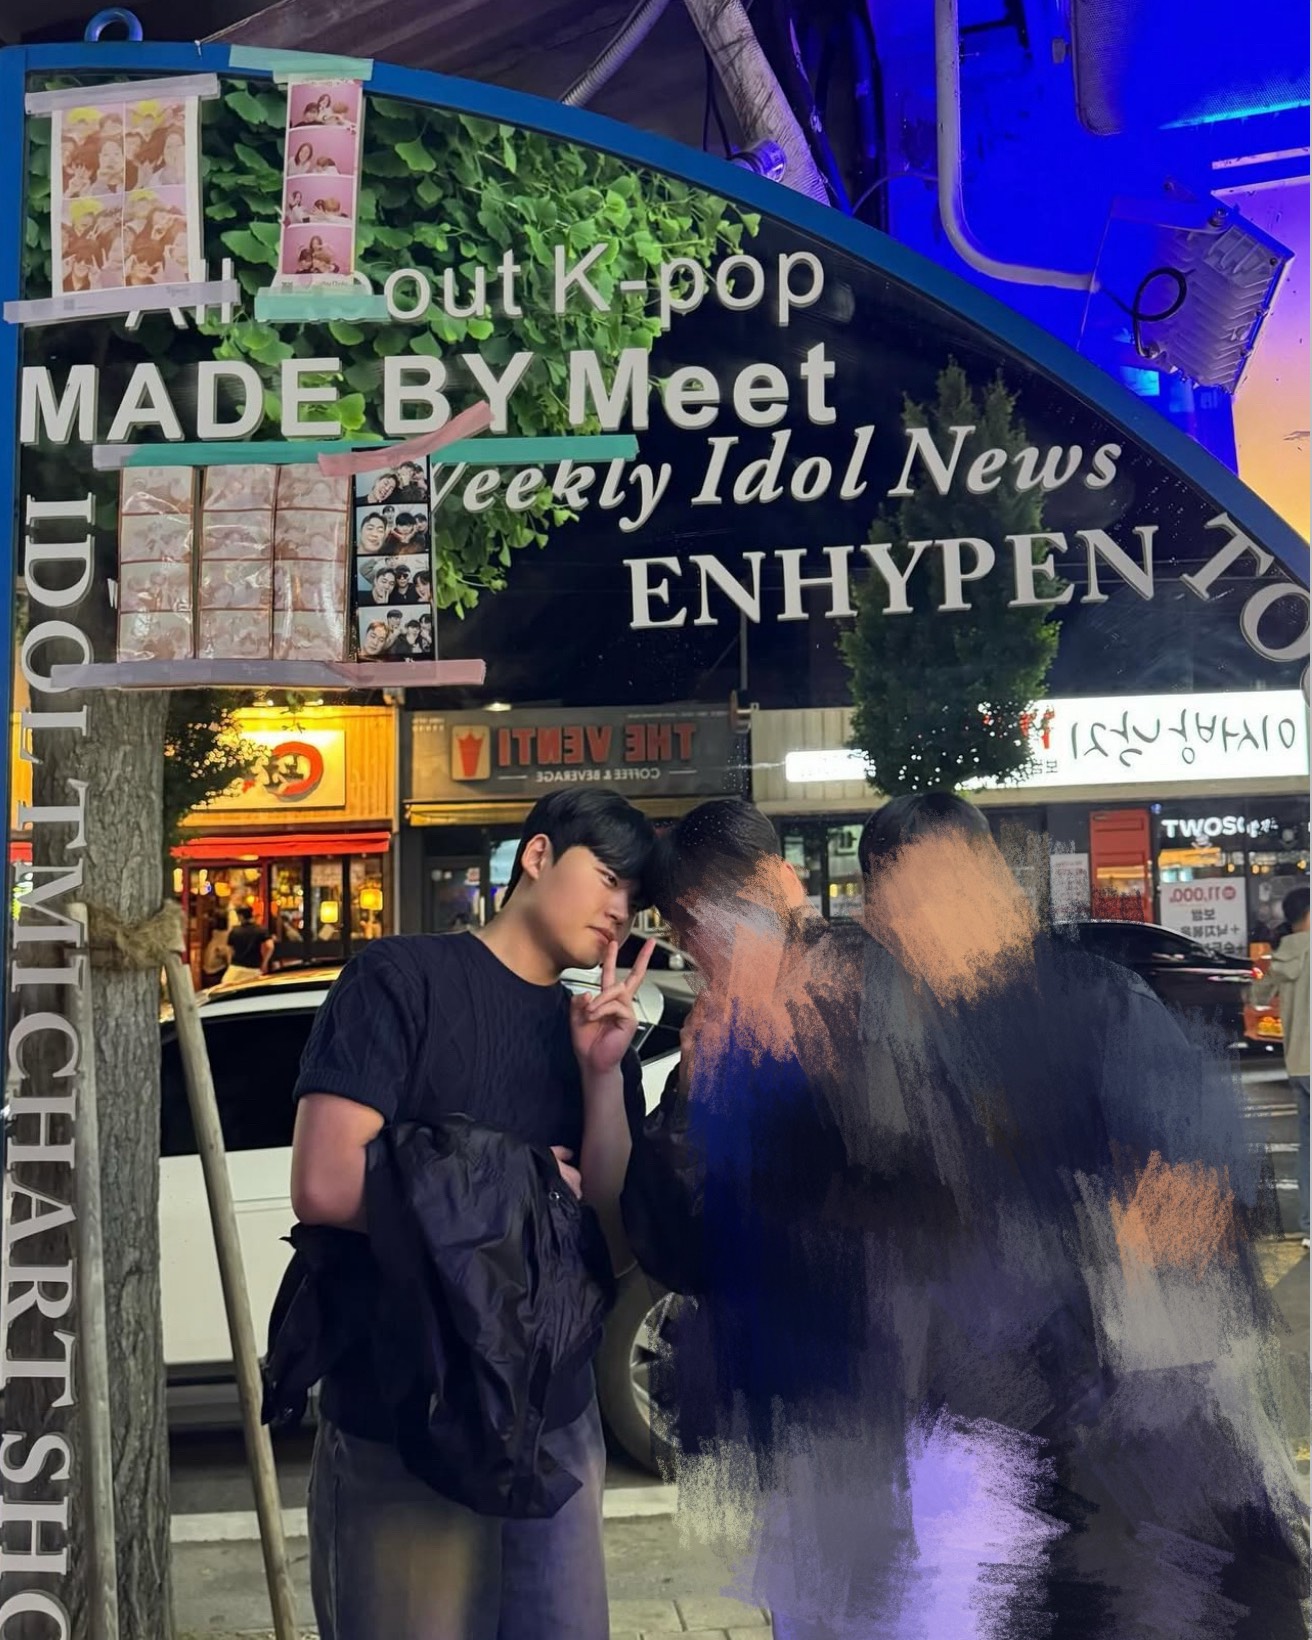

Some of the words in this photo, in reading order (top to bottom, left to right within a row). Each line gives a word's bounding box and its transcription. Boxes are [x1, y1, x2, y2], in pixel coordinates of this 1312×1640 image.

[345, 248, 522, 323] out
[555, 243, 825, 329] K-pop
[20, 357, 342, 444] MADE
[383, 351, 534, 437] BY
[568, 342, 838, 431] Meet
[691, 424, 876, 506] Idol
[888, 424, 1124, 497] News
[20, 491, 96, 767] IDOL
[622, 524, 1159, 631] ENHYPEN
[1180, 511, 1310, 706] TO
[11, 778, 90, 994] TMI
[3, 1010, 80, 1409] CHART
